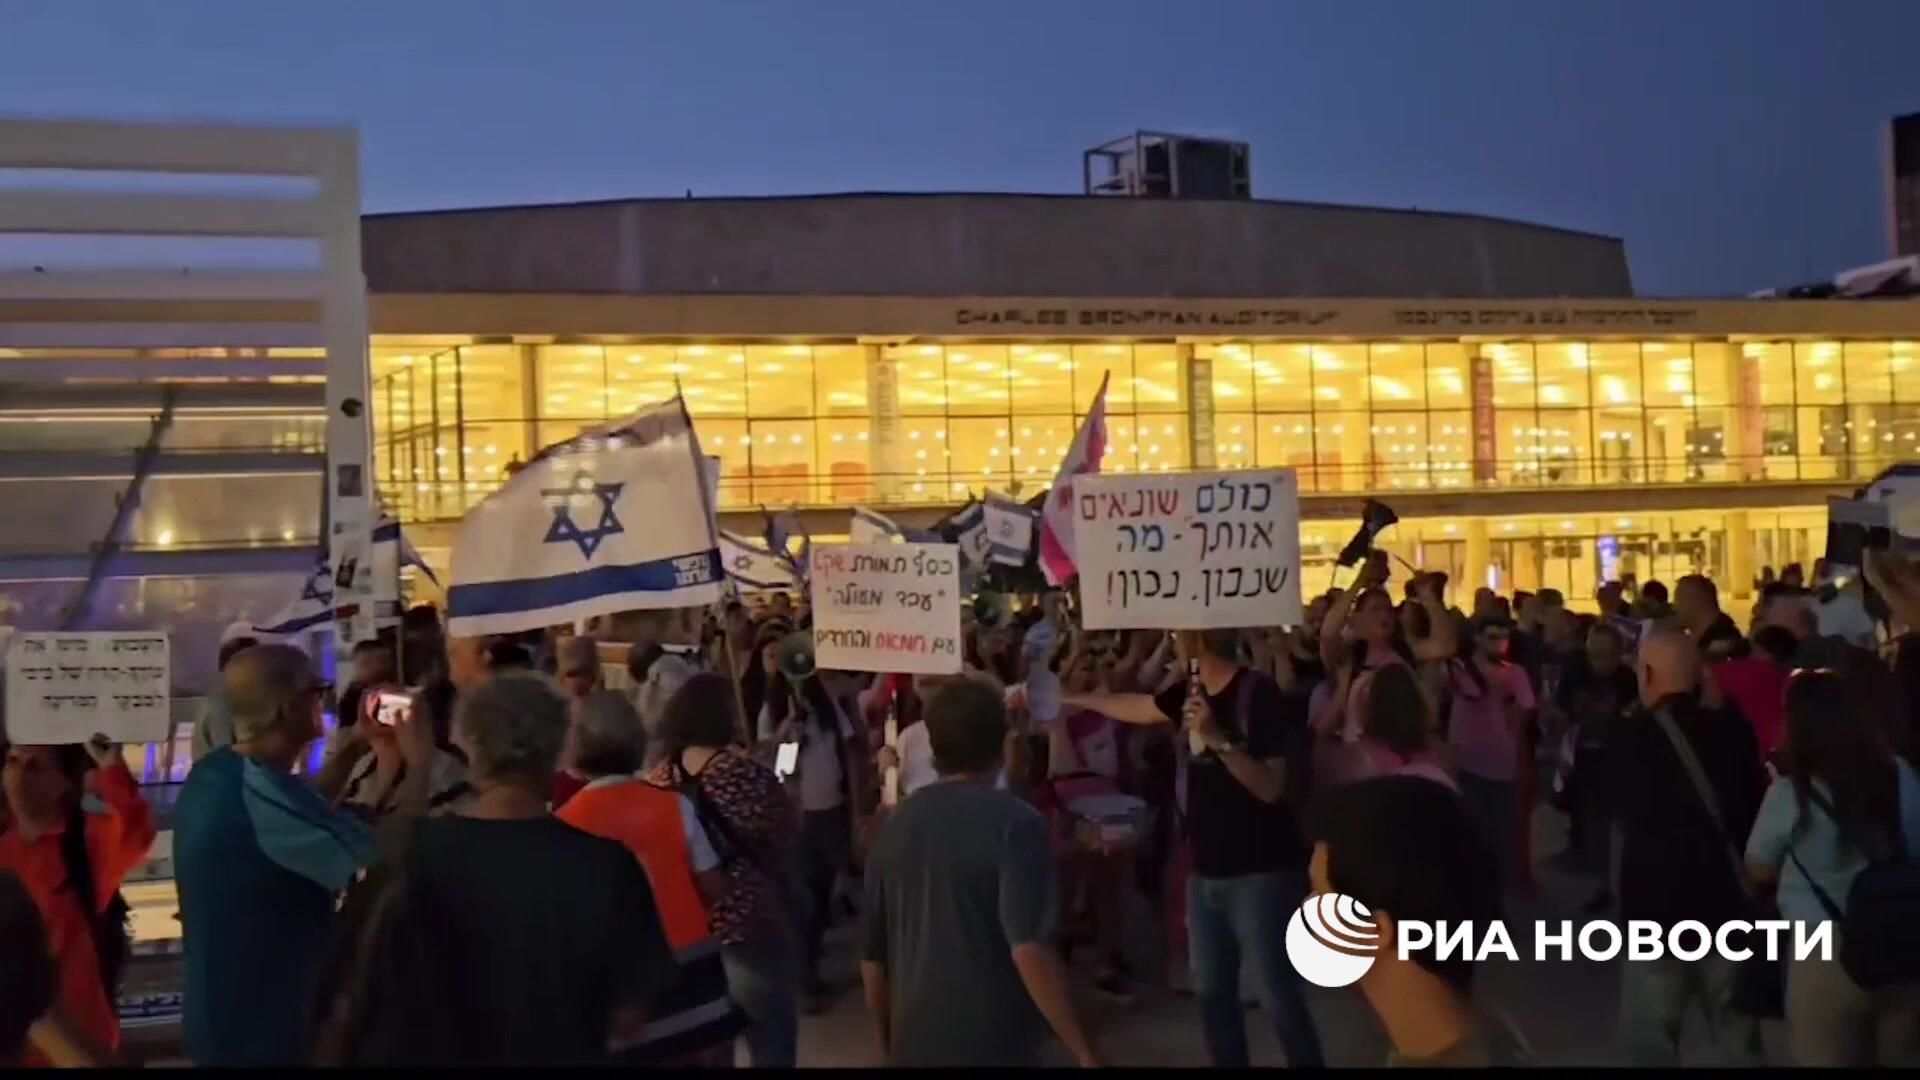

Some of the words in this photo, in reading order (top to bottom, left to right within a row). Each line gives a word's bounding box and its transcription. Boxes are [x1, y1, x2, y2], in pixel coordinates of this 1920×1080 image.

[1080, 488, 1179, 521] שונאים
[1117, 523, 1164, 552] מה
[850, 554, 908, 573] תמורת
[913, 551, 953, 577] כסף
[1107, 569, 1180, 608] נכון!
